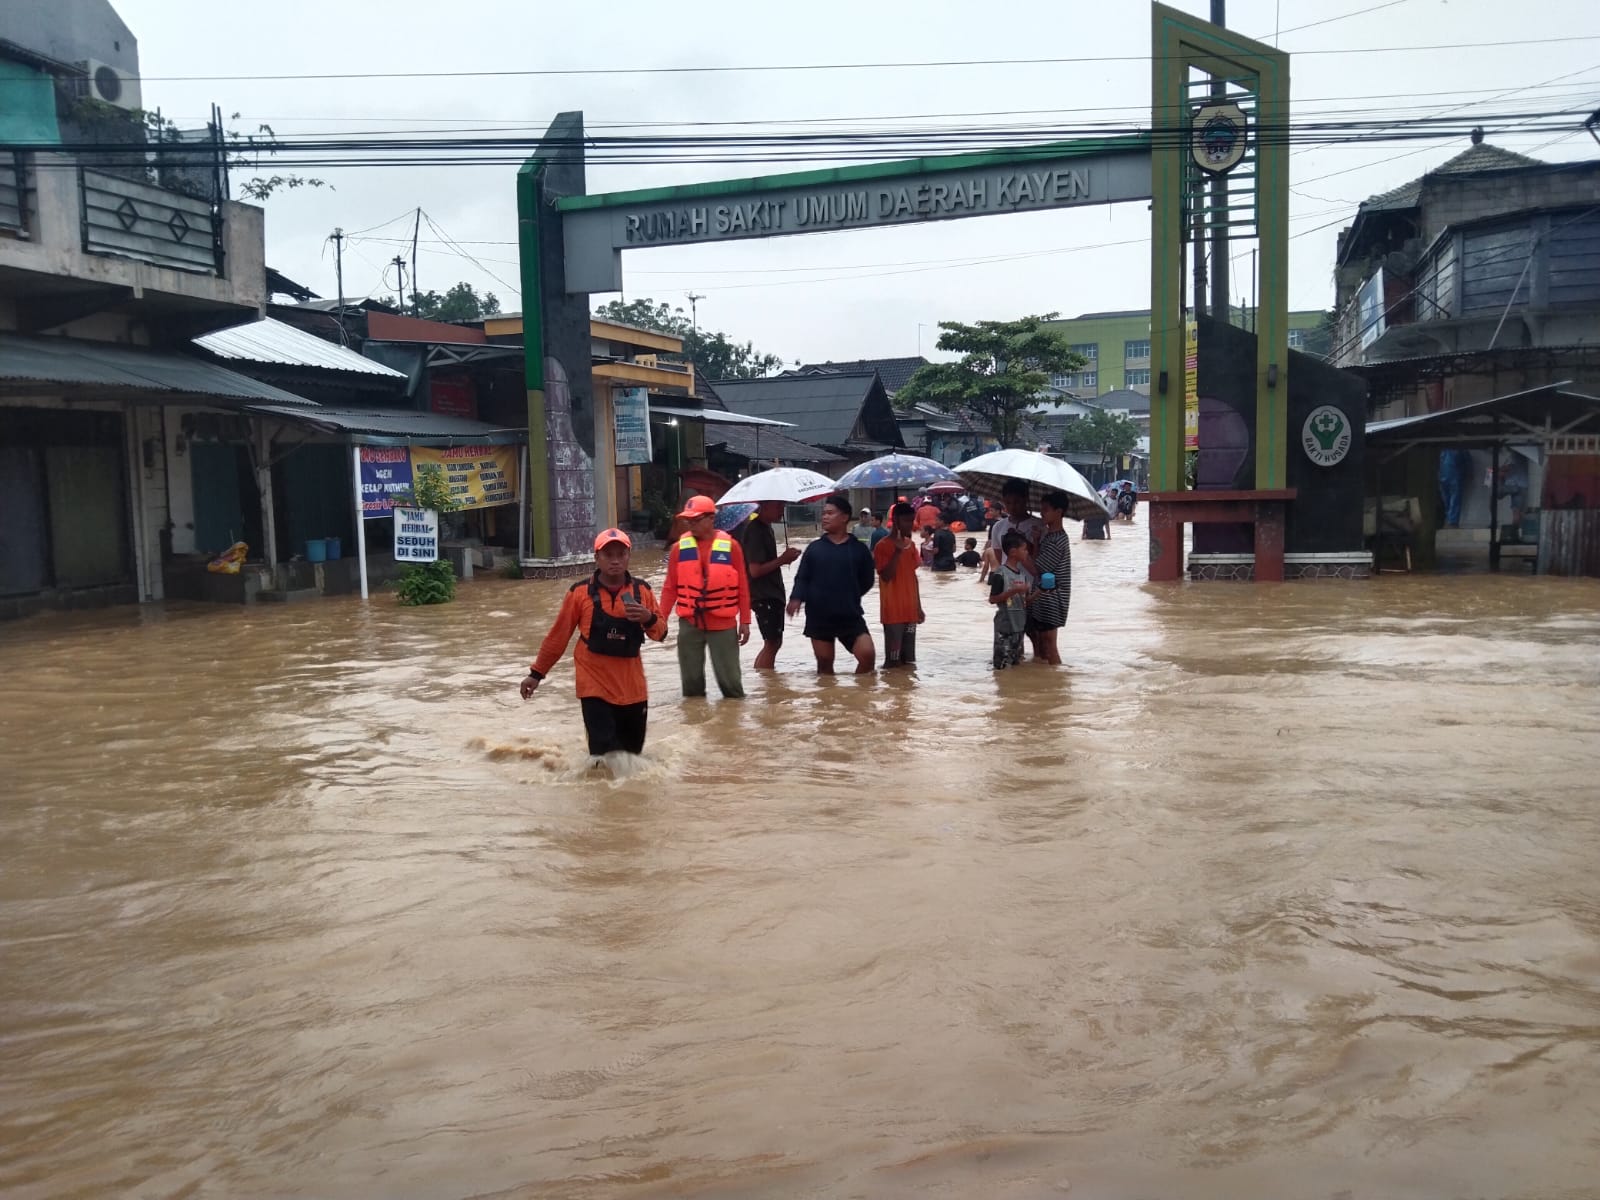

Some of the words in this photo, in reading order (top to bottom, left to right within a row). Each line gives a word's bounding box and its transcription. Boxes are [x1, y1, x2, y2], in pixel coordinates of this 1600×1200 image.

[625, 207, 708, 242] RUMAH
[714, 201, 785, 233] SAKIT
[792, 190, 868, 226] UMUM
[879, 177, 987, 218] DAERAH
[997, 168, 1089, 206] KAYEN
[1305, 437, 1323, 461] BAKTI
[1324, 435, 1349, 462] HUSADA
[375, 469, 393, 479] AGEN
[406, 511, 425, 522] JAMU
[401, 523, 429, 533] HERBAL
[397, 536, 435, 546] SEDUH
[397, 547, 409, 557] DI
[411, 548, 435, 558] SINI
